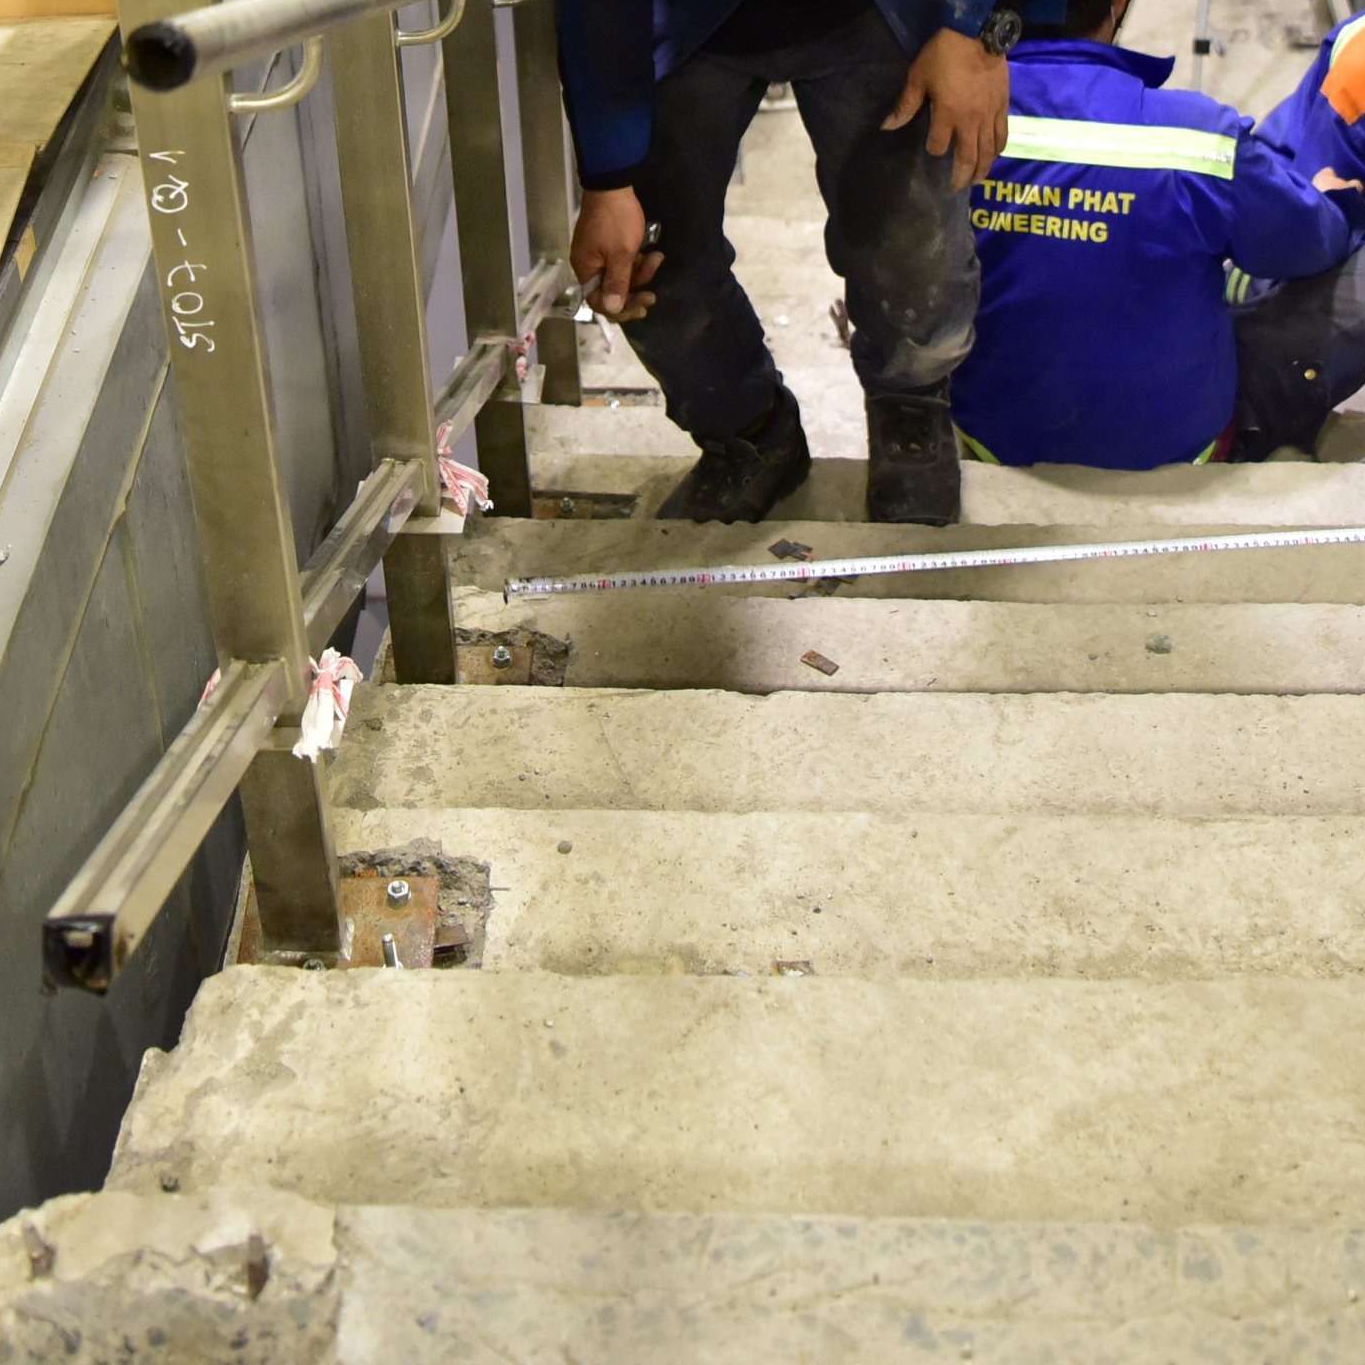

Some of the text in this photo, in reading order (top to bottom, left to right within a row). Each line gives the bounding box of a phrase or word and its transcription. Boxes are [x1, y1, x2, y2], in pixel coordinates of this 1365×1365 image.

[980, 179, 1136, 215] THUAN PHAT
[969, 208, 1109, 243] GINEERING
